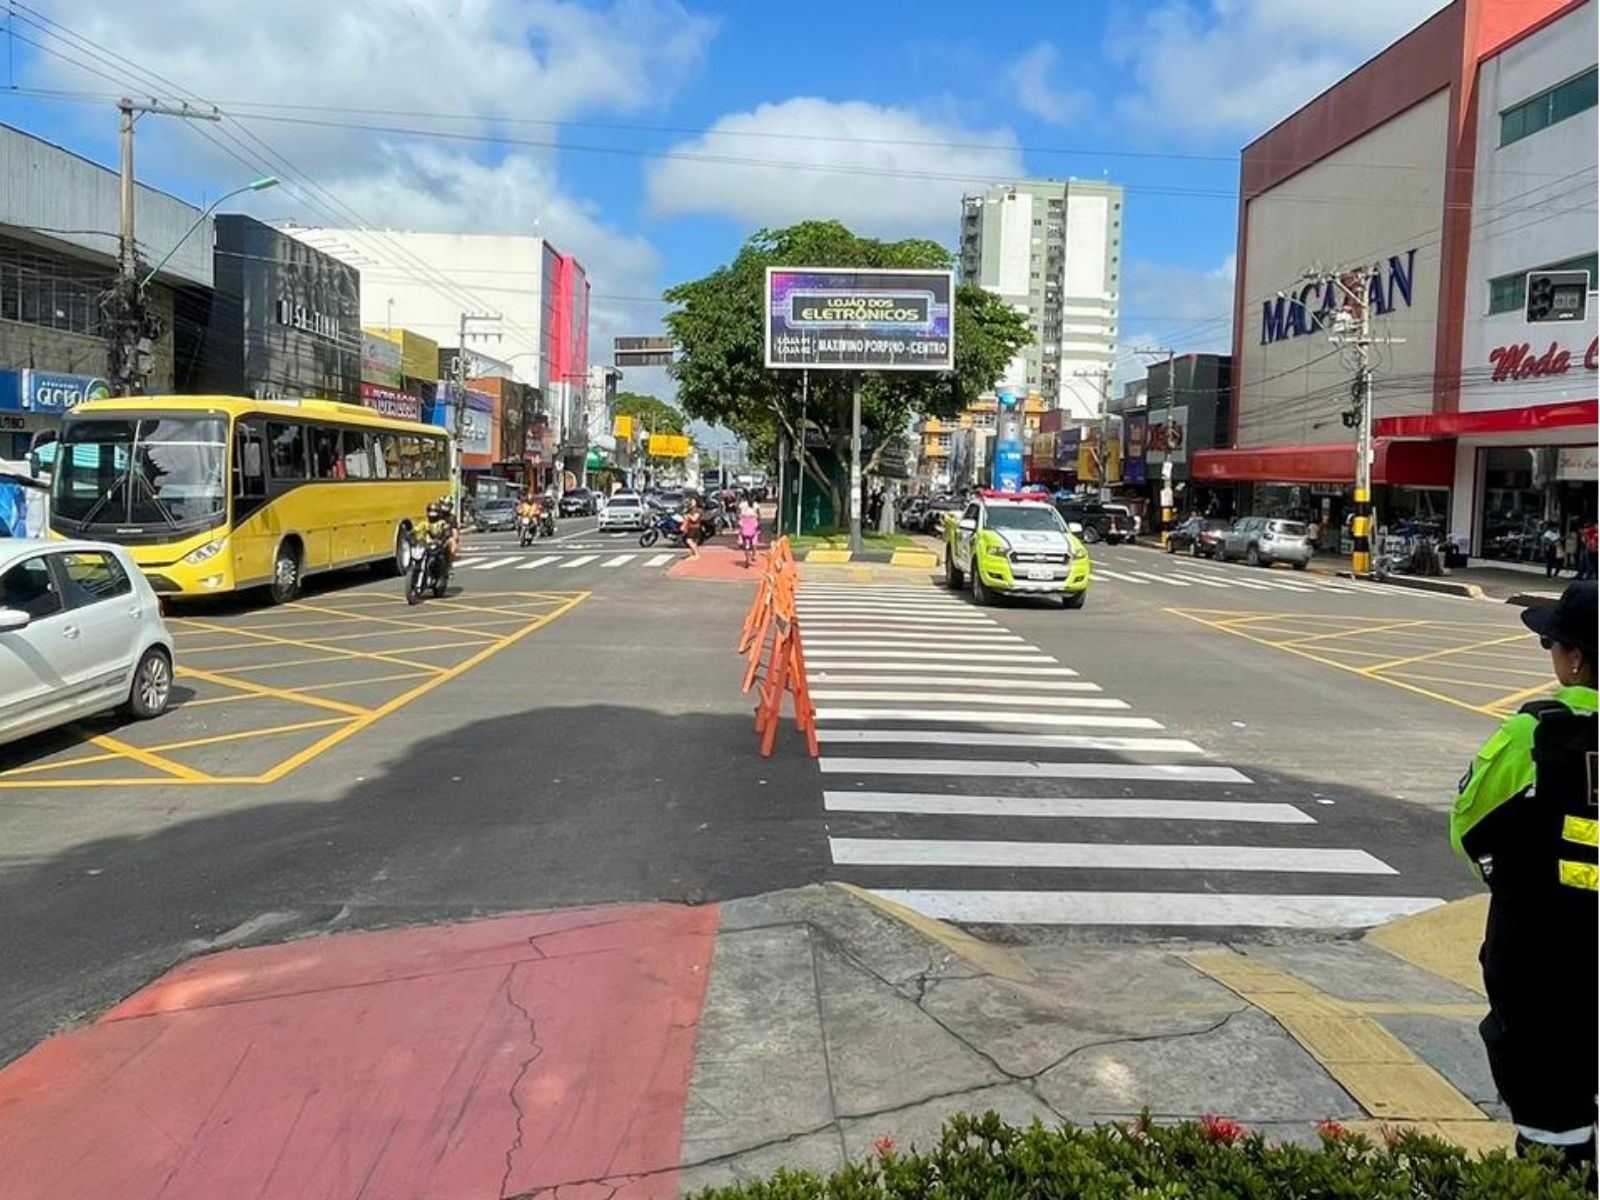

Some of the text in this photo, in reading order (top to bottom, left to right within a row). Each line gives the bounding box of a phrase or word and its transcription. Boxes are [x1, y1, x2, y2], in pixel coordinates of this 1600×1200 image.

[827, 297, 894, 308] LOJÃO DOS
[801, 306, 919, 321] ELETRÔNICOS
[911, 341, 947, 354] CENTRO
[1489, 341, 1571, 382] Moda
